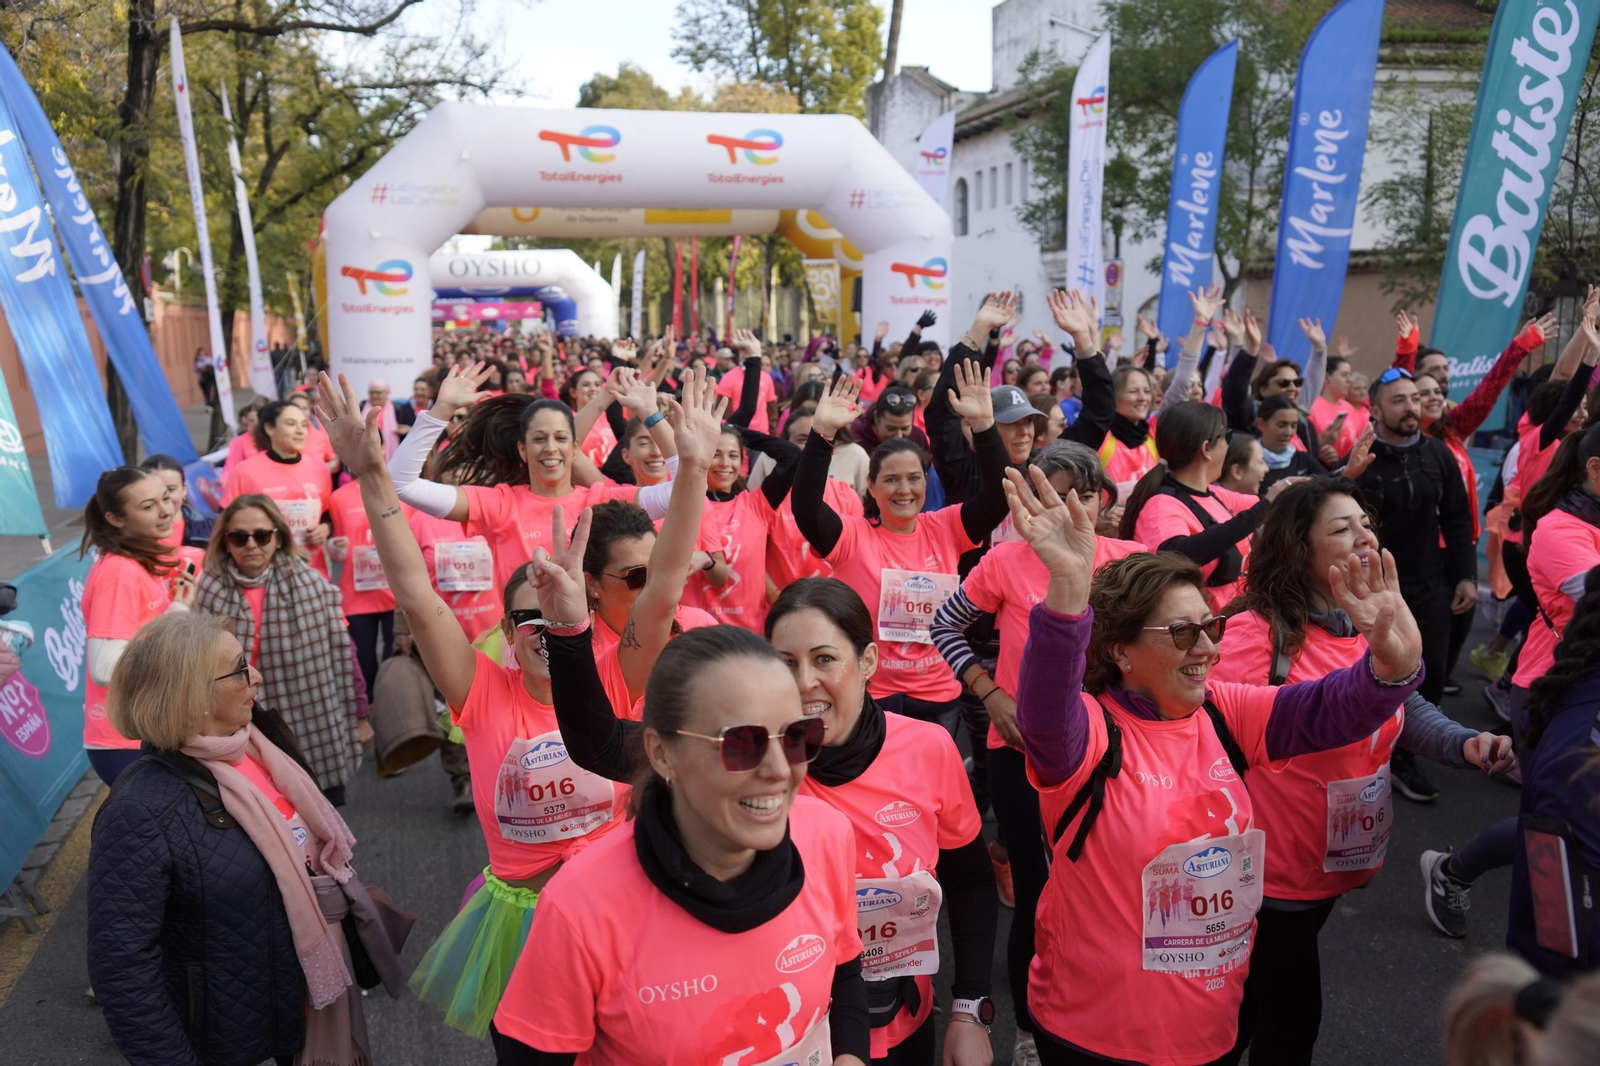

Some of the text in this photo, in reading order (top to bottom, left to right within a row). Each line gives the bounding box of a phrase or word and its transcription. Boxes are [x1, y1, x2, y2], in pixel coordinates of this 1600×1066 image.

[1458, 0, 1580, 308] Batiste
[539, 170, 622, 184] TotalEnergies
[707, 173, 784, 185] TotalEnergies
[1287, 109, 1352, 269] Marlene
[1168, 151, 1216, 287] Marlene
[449, 257, 541, 277] OYSHO
[341, 303, 414, 315] TotalEnergies
[1010, 390, 1026, 405] A
[454, 562, 475, 570] 016
[906, 601, 932, 614] 016
[882, 660, 914, 669] CARRERA
[15, 713, 44, 745] ESPAÑA
[523, 749, 568, 767] ASTURIANA
[529, 777, 575, 802] 016
[543, 803, 566, 814] 5379
[511, 817, 535, 825] CARRERA
[553, 811, 573, 822] MUJER
[569, 815, 601, 830] Santander
[880, 810, 918, 822] ASTURIANA
[510, 828, 546, 838] OYSHO
[1187, 856, 1229, 872] ASTURIANA
[1336, 856, 1370, 867] OYSHO
[1153, 867, 1179, 876] SUMA
[857, 897, 897, 908] TURIANA
[1191, 889, 1233, 916] 016
[1205, 921, 1226, 934] 5655
[1163, 938, 1194, 946] CARRERA
[1214, 934, 1230, 943] MUJER
[780, 943, 823, 969] ASTURIANA
[868, 955, 890, 966] MUJER
[894, 946, 918, 959] SEVILLA
[1160, 952, 1204, 963] OYSHO
[884, 959, 923, 971] Santander
[638, 974, 717, 1004] OYSHO
[1205, 977, 1226, 992] 2025
